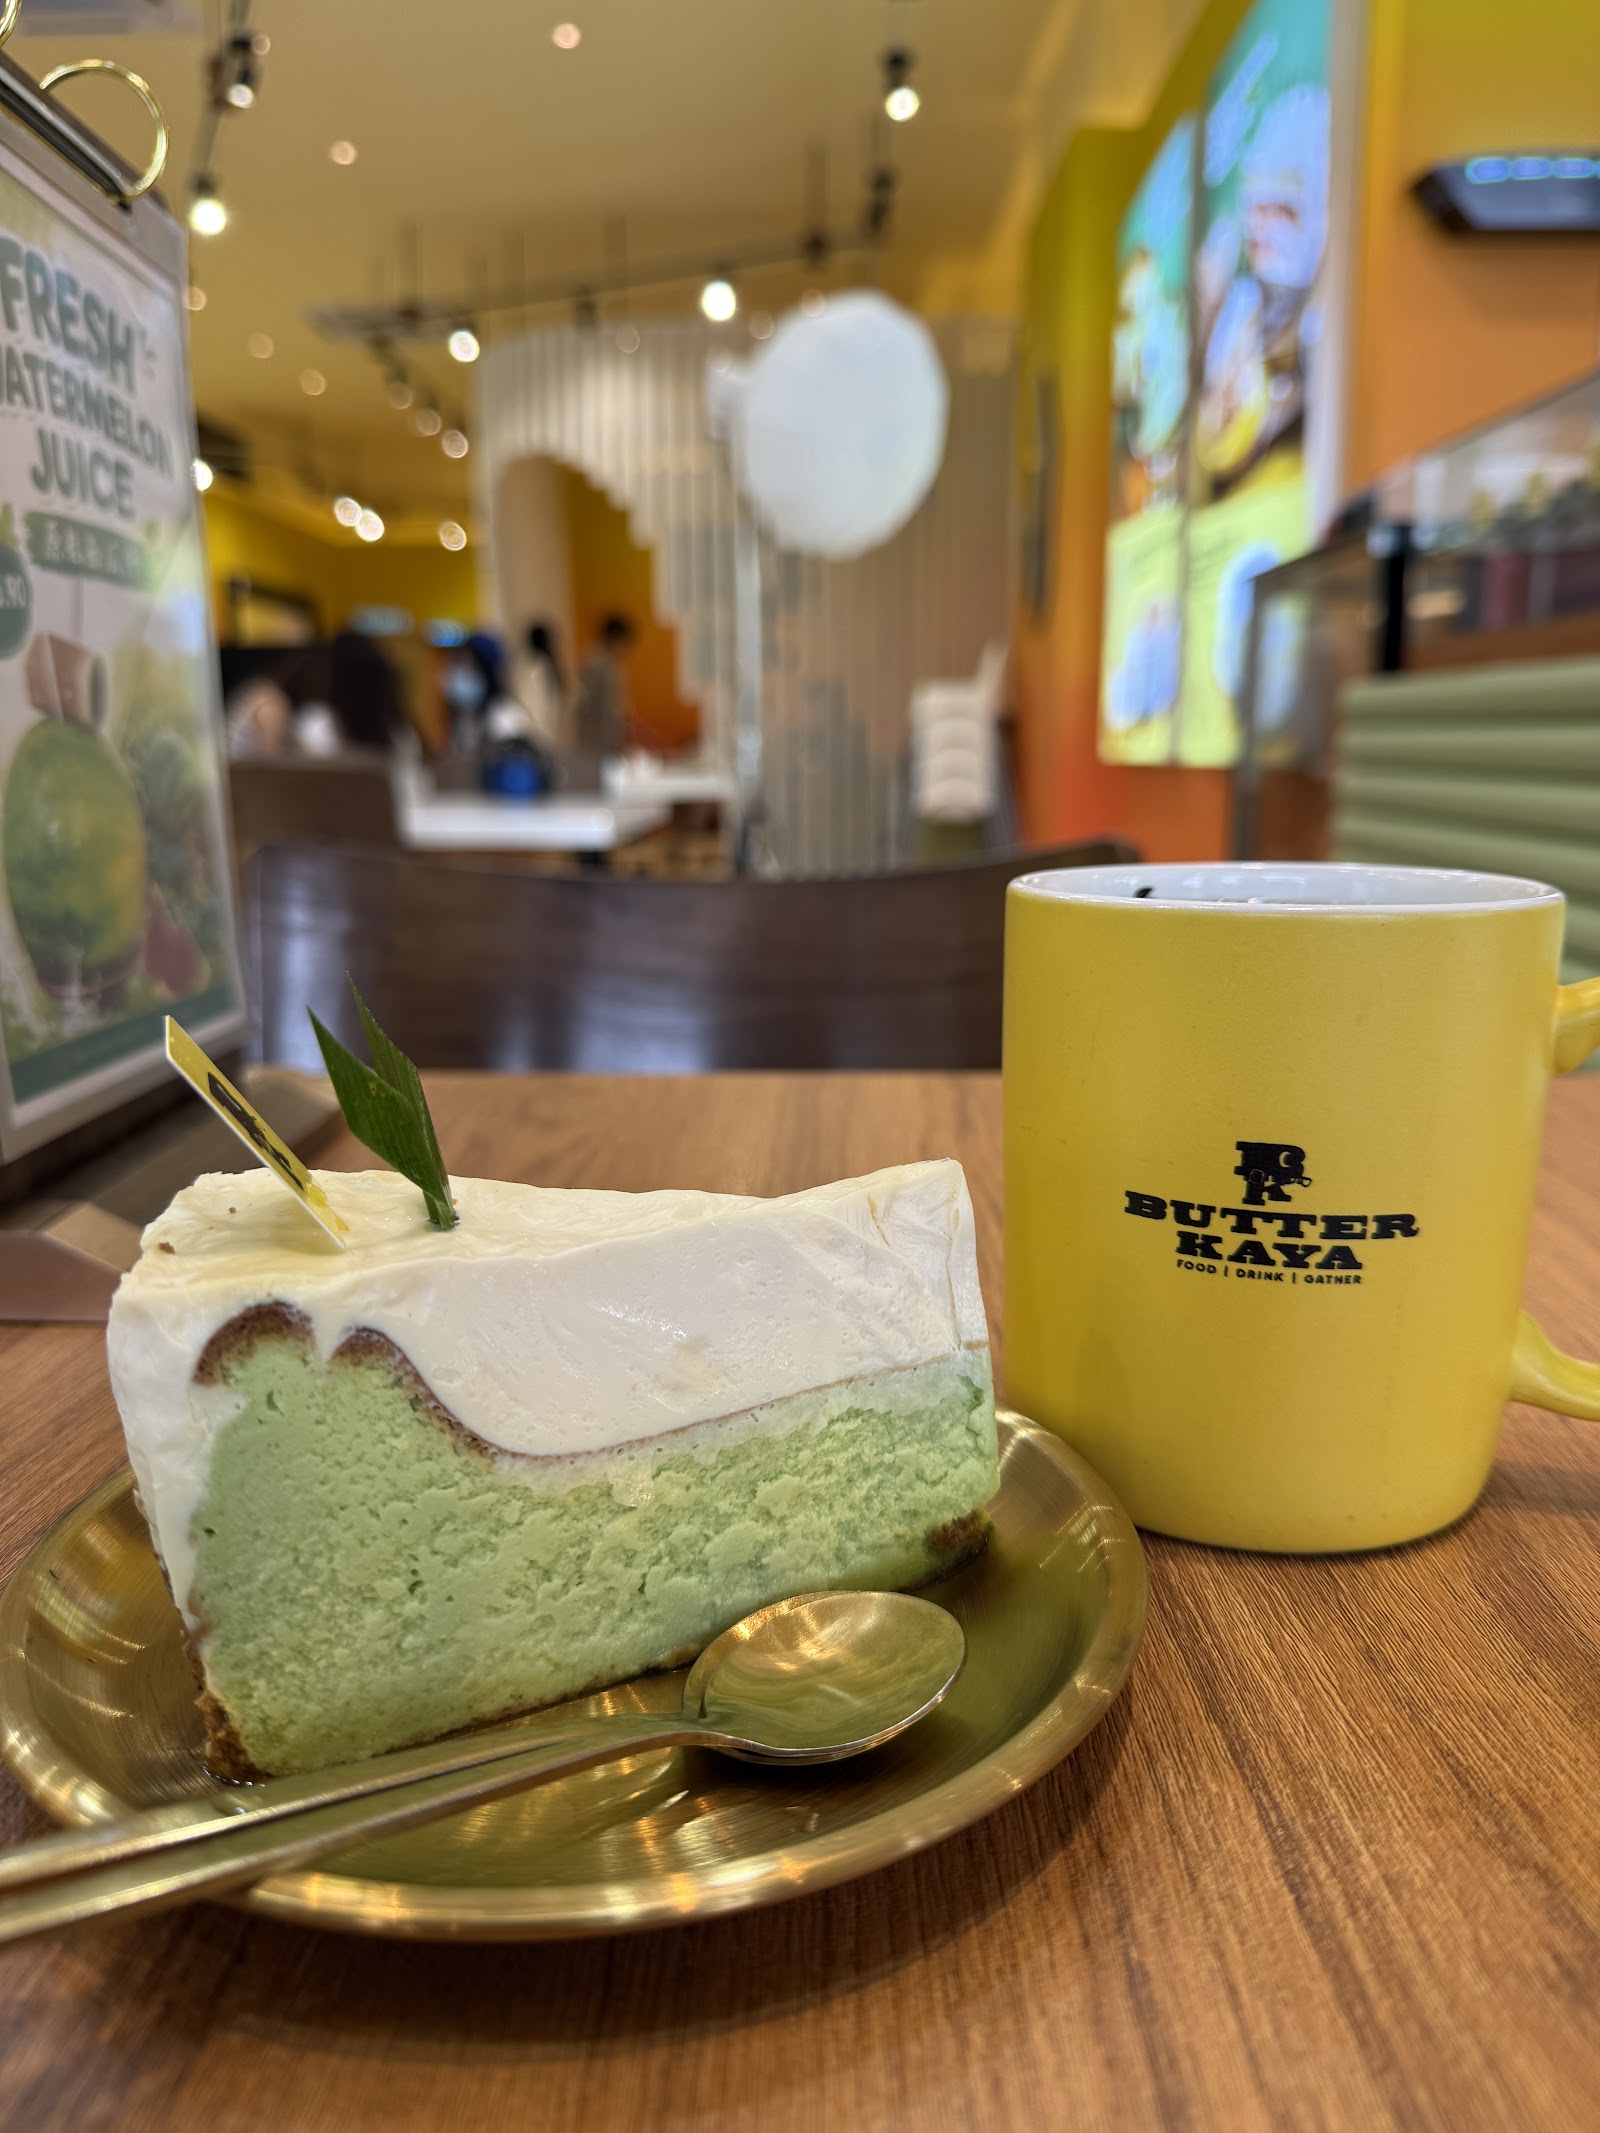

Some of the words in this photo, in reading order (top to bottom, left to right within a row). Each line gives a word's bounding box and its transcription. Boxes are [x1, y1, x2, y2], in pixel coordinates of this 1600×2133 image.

[0, 235, 135, 395] FRESH
[0, 344, 174, 478] ATERMELON
[31, 426, 135, 519] JUICE
[1124, 1190, 1419, 1240] BUTTER
[1175, 1230, 1363, 1270] KAYA
[1176, 1259, 1217, 1275] FOOD
[1235, 1268, 1284, 1282] DRINK
[1303, 1274, 1362, 1285] GATHER
